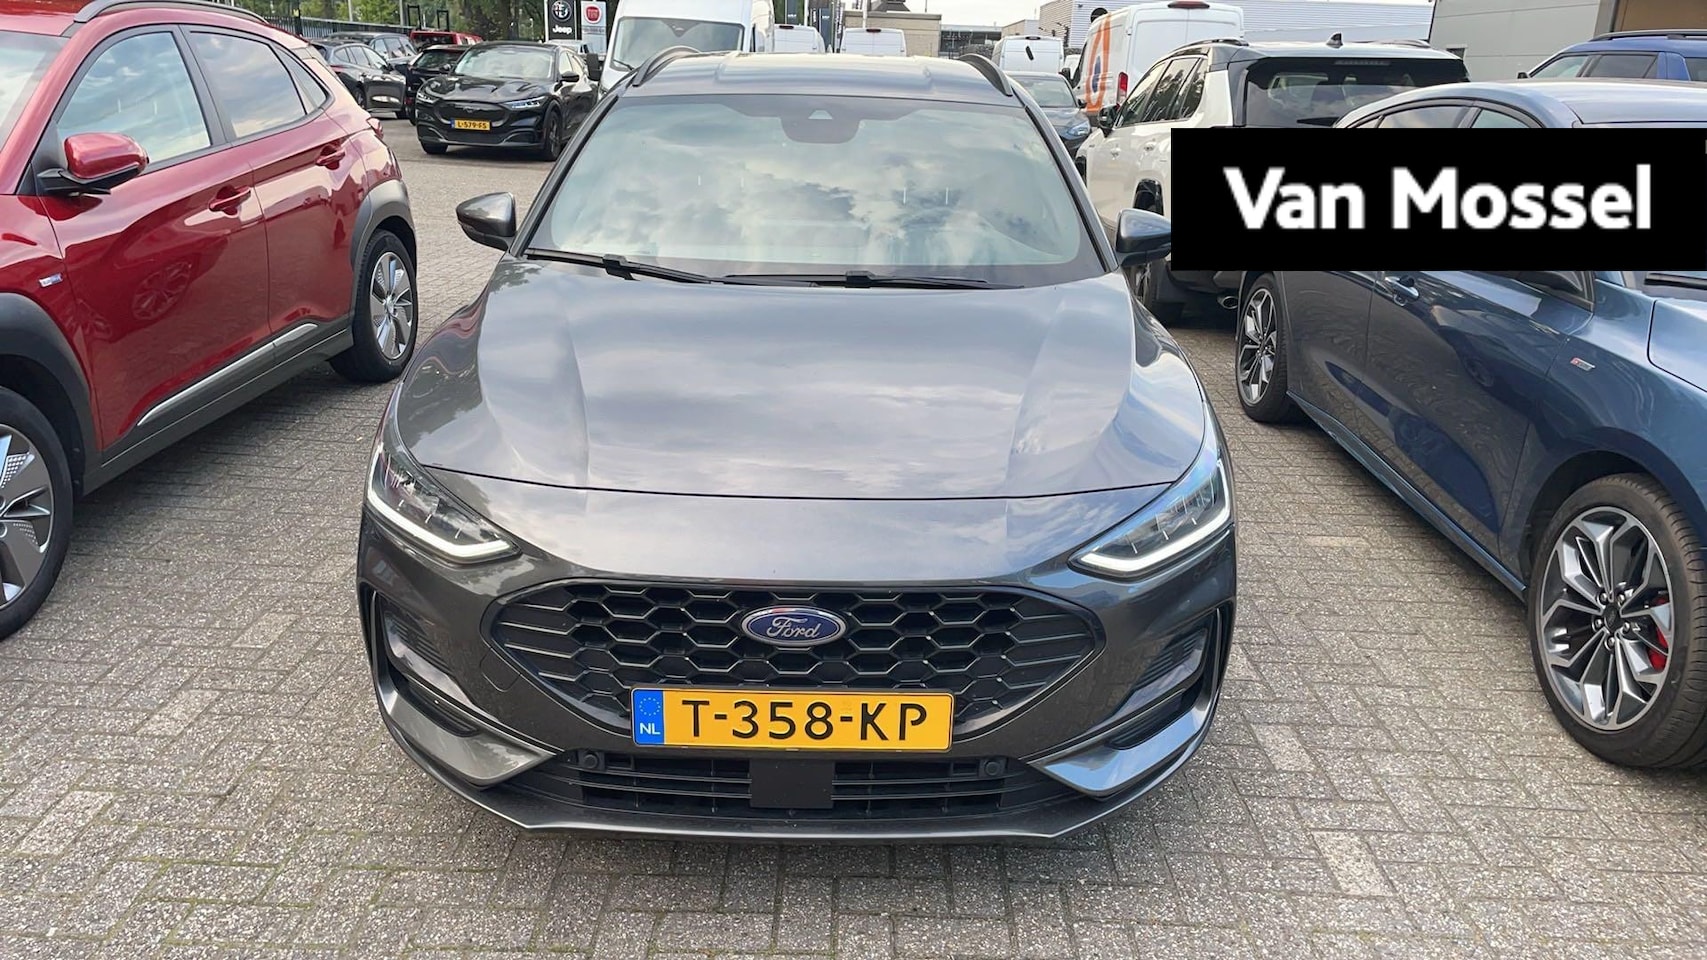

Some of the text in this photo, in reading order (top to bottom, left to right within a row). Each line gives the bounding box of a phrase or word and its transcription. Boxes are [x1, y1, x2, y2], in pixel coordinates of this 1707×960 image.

[766, 616, 821, 638] Ford
[639, 722, 661, 736] NL
[682, 699, 928, 742] T-358-KP
